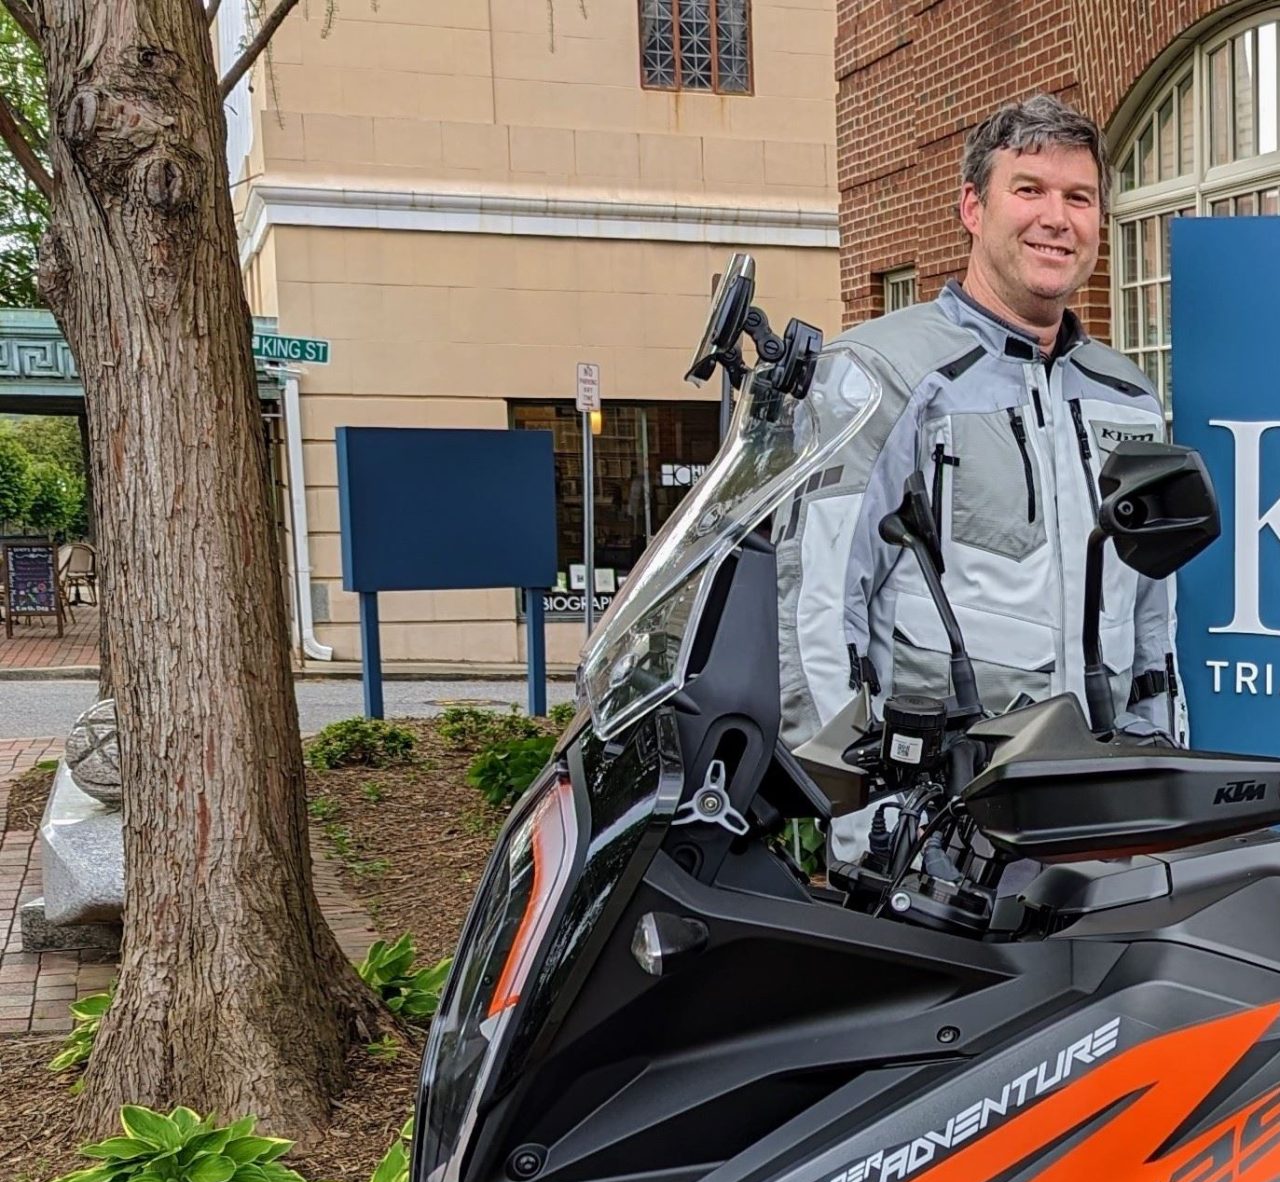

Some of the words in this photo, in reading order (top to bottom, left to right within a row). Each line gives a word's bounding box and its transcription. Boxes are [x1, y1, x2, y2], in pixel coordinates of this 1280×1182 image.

[261, 337, 301, 358] KING
[305, 341, 327, 360] ST
[543, 596, 612, 611] BIOGRAP
[1213, 780, 1267, 805] KTM
